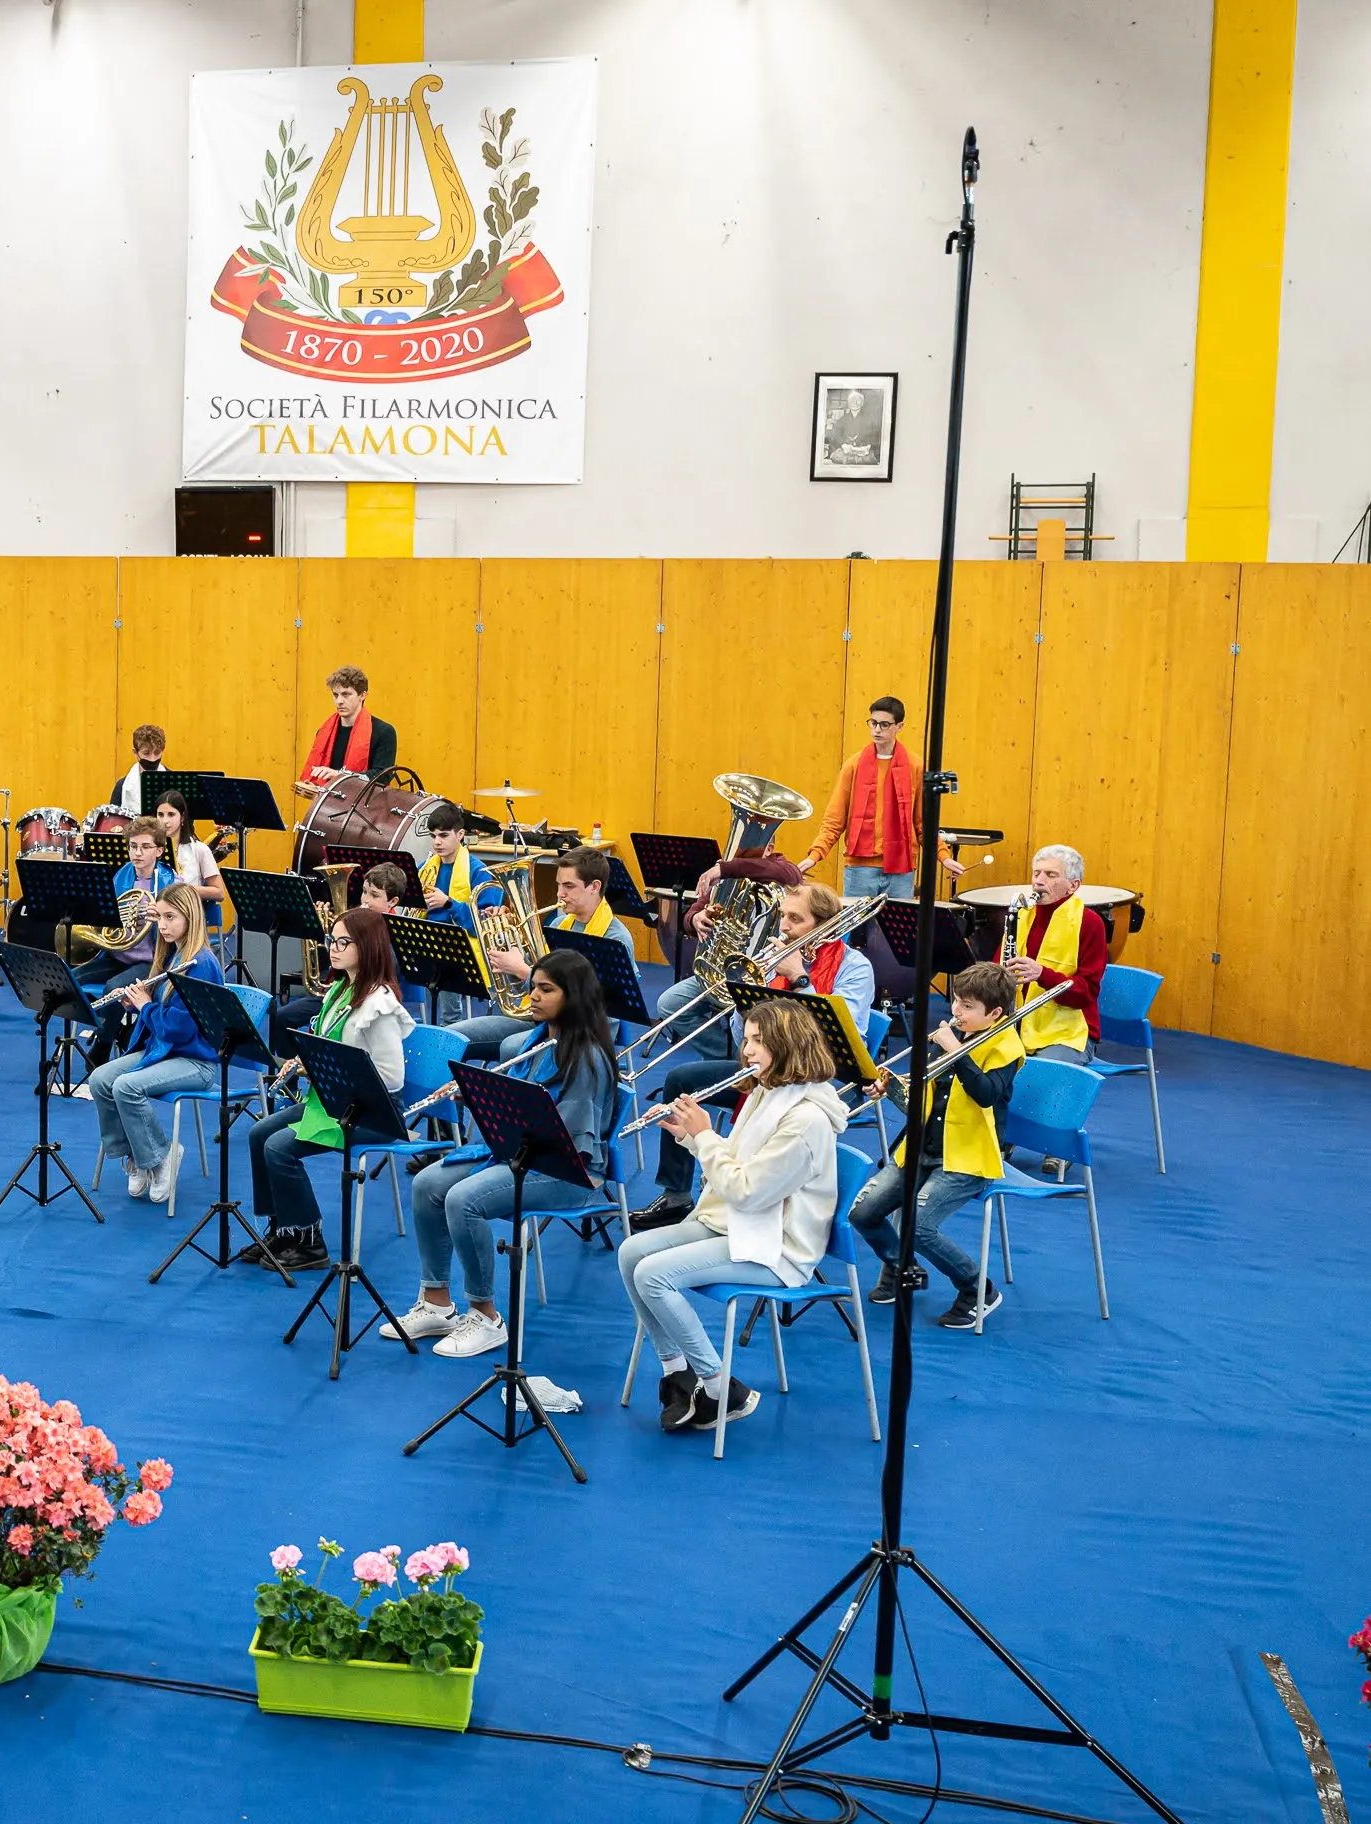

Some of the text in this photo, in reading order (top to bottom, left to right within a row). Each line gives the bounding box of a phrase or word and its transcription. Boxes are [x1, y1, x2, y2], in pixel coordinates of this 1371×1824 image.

[281, 330, 363, 365] 1870
[400, 327, 484, 366] 2020
[210, 393, 559, 420] SOCIETÀ FILARMONICA
[249, 423, 509, 456] TALAMONA
